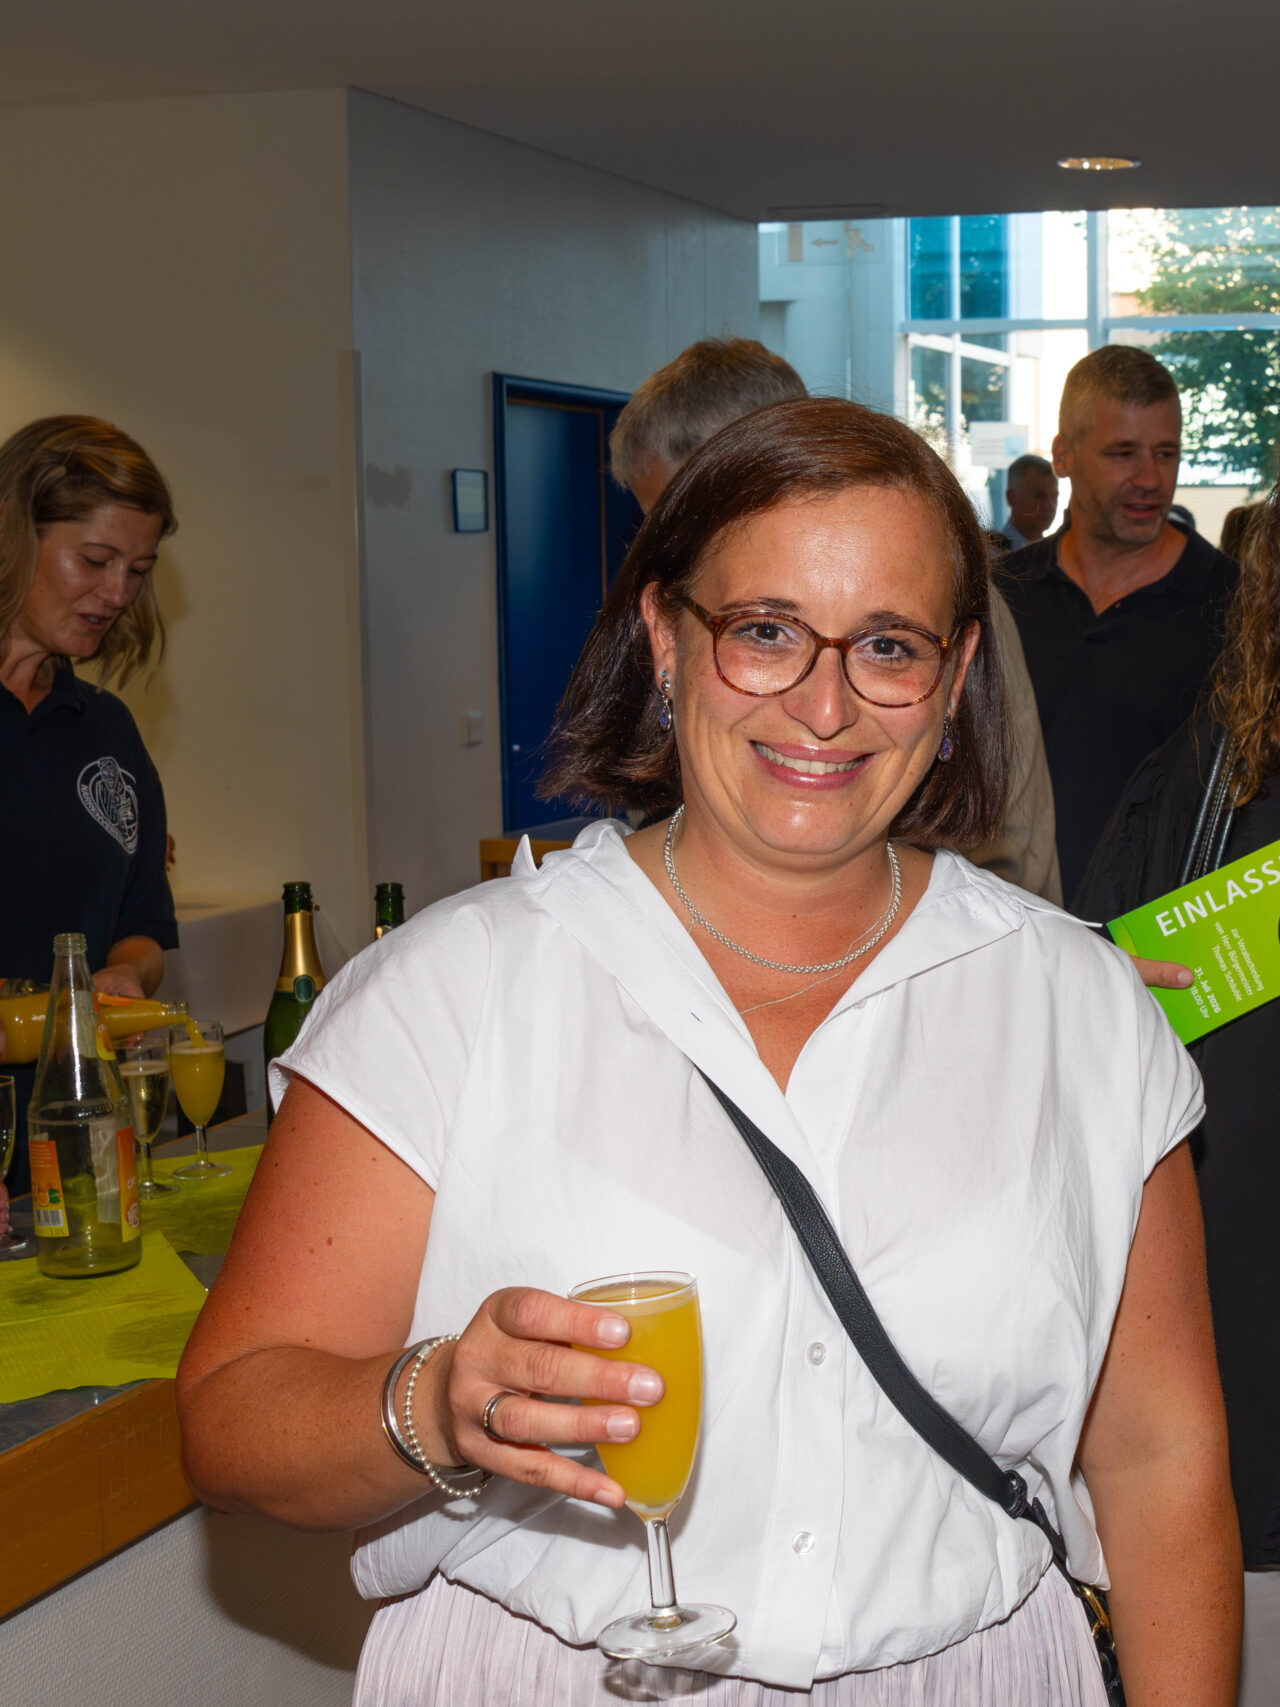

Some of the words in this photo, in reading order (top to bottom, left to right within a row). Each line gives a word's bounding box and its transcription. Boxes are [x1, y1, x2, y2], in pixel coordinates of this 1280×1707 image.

[1212, 944, 1228, 972] Thomas
[1214, 921, 1224, 935] von
[1221, 935, 1232, 950] Herr
[1228, 950, 1254, 996] Bürgermeister
[1231, 928, 1241, 939] zur
[1237, 938, 1265, 992] Verabschiedung
[1194, 966, 1204, 979] 31.
[1200, 980, 1211, 993] Juli
[1199, 1005, 1209, 1018] Uhr
